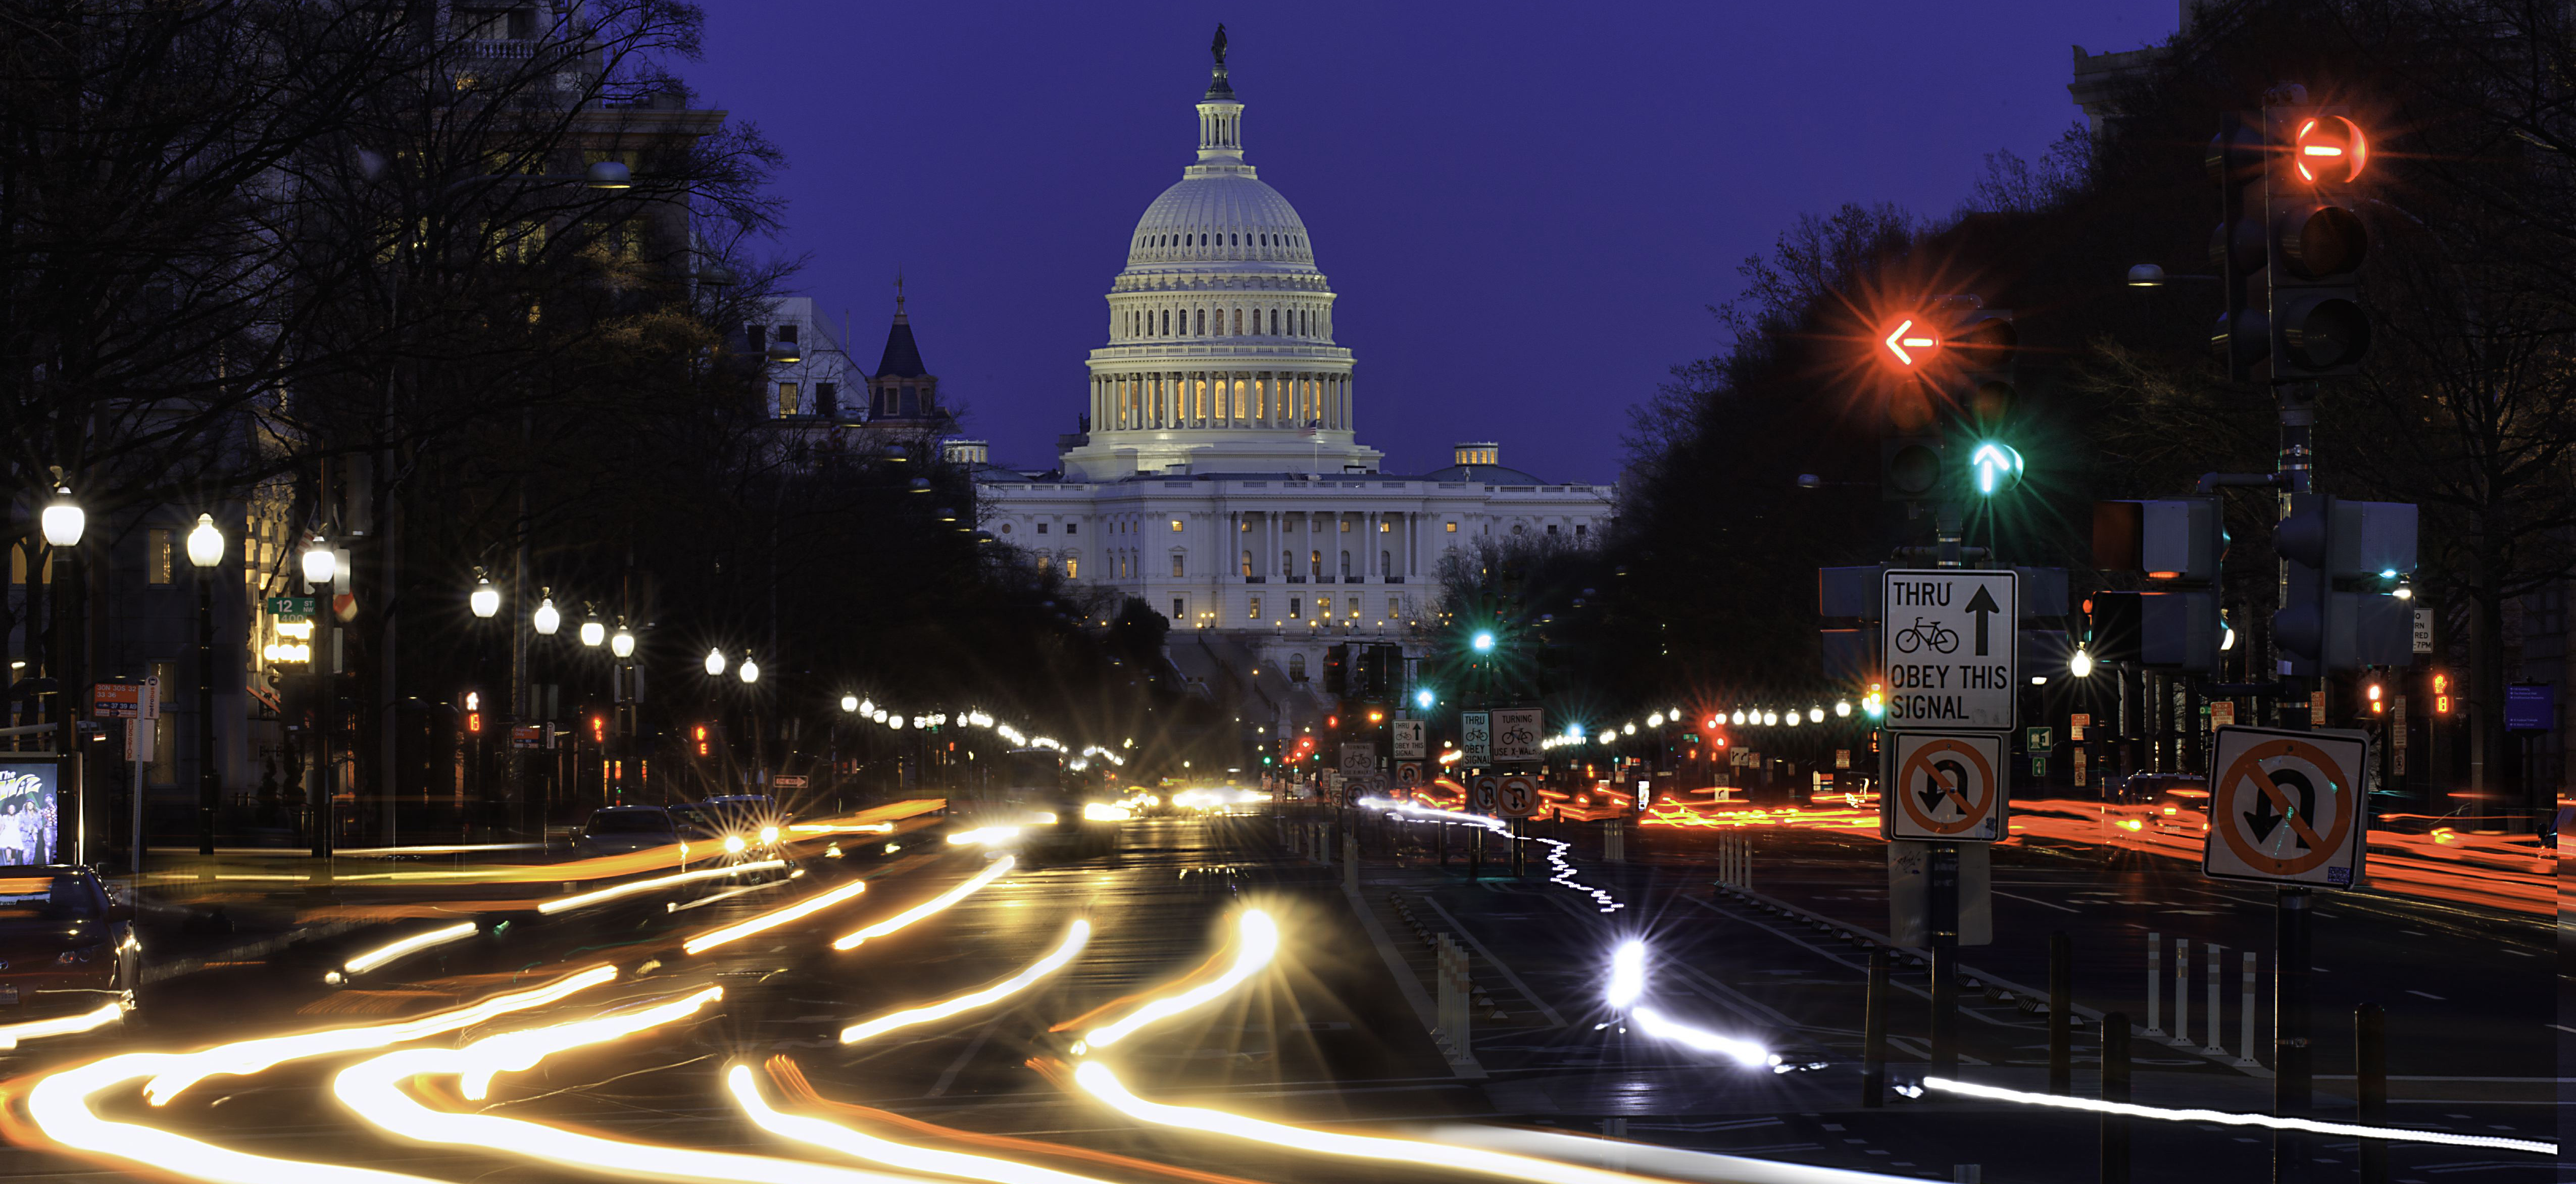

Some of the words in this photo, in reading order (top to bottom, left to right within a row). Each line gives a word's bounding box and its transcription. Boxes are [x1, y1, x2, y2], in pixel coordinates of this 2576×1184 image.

[1894, 582, 1951, 606] THRU
[276, 600, 292, 612] 12
[281, 614, 304, 623] 400
[1891, 664, 1950, 689] OBEY
[1959, 665, 2007, 689] THIS
[1891, 695, 1969, 719] SIGNAL
[1465, 715, 1485, 725] THRU
[1502, 714, 1532, 723] TURNING
[1465, 745, 1485, 753] OBEY
[1494, 748, 1508, 756] USE
[1465, 756, 1491, 764] SIGNAL
